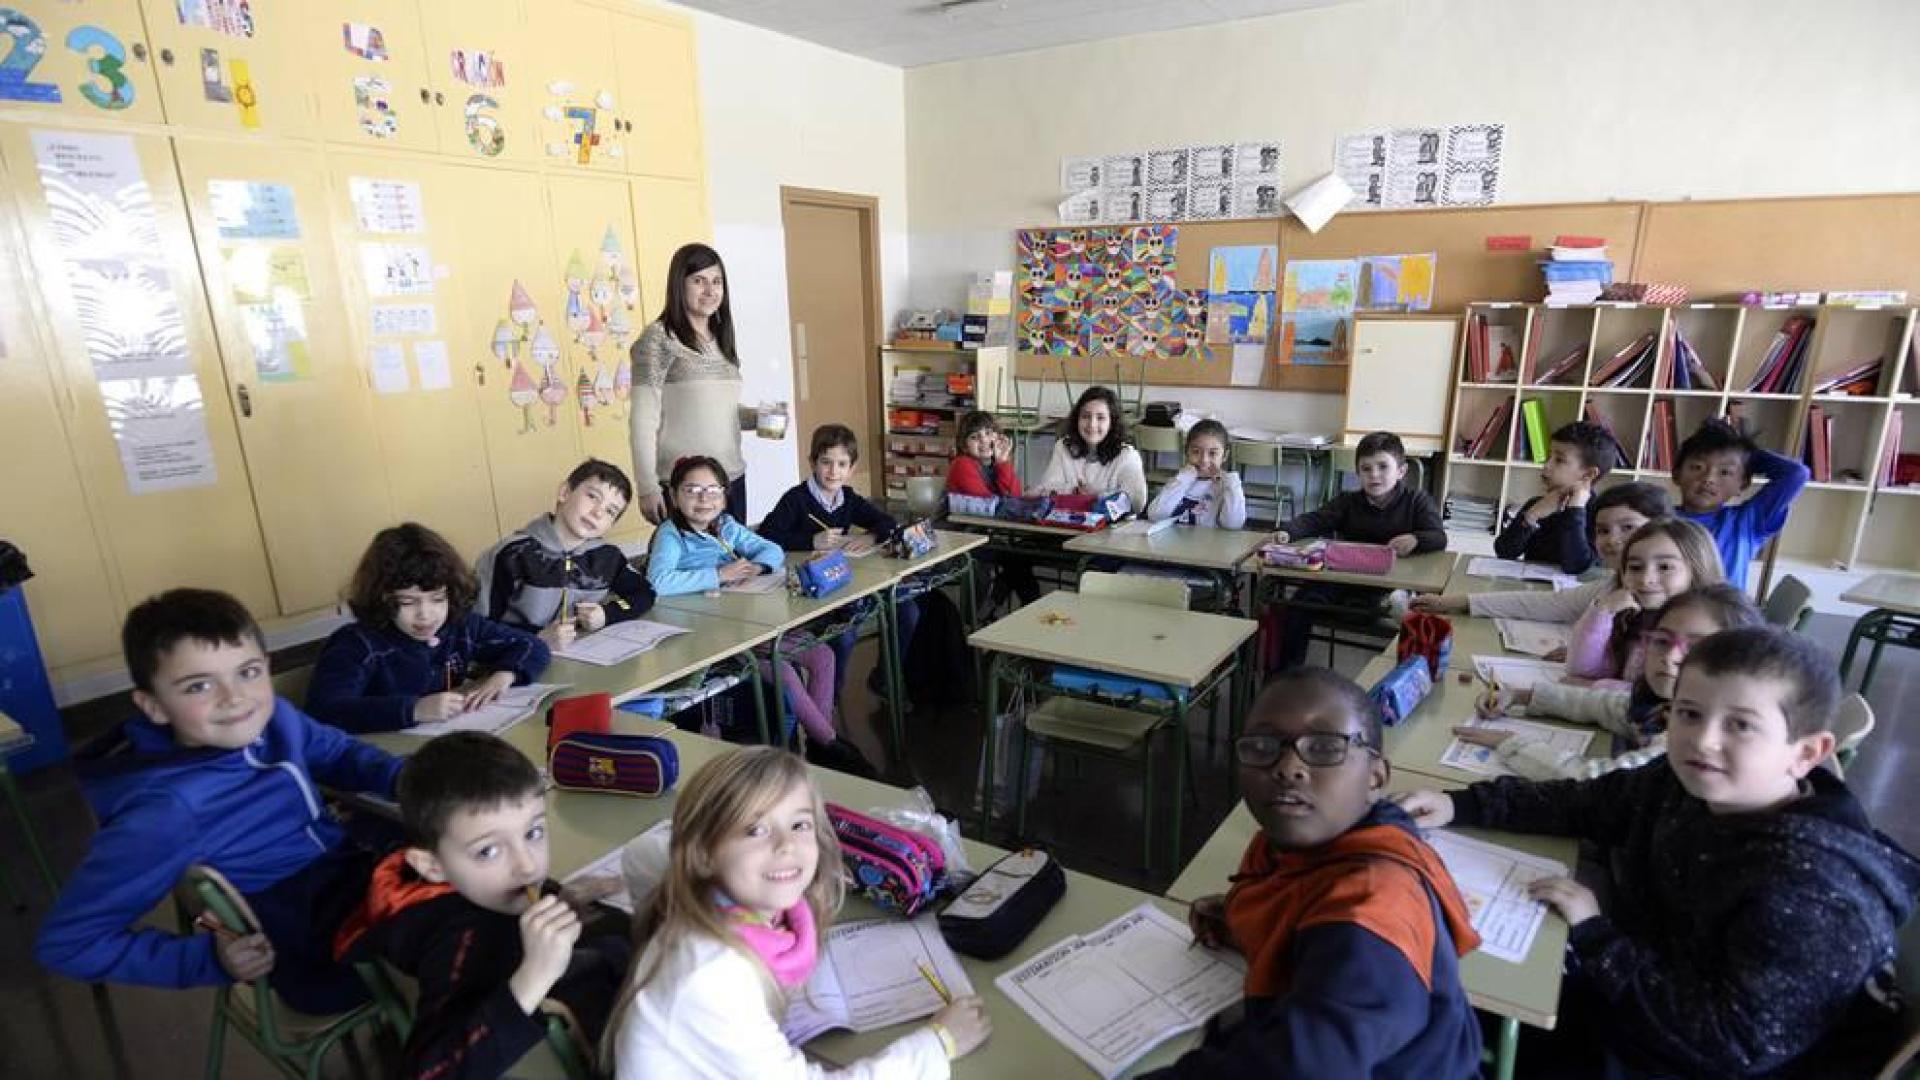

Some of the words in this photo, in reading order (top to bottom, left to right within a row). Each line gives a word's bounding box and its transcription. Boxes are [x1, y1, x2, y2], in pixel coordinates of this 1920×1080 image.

[0, 8, 62, 103] 2
[66, 25, 135, 110] 3
[465, 93, 505, 156] 6
[564, 106, 600, 164] 7
